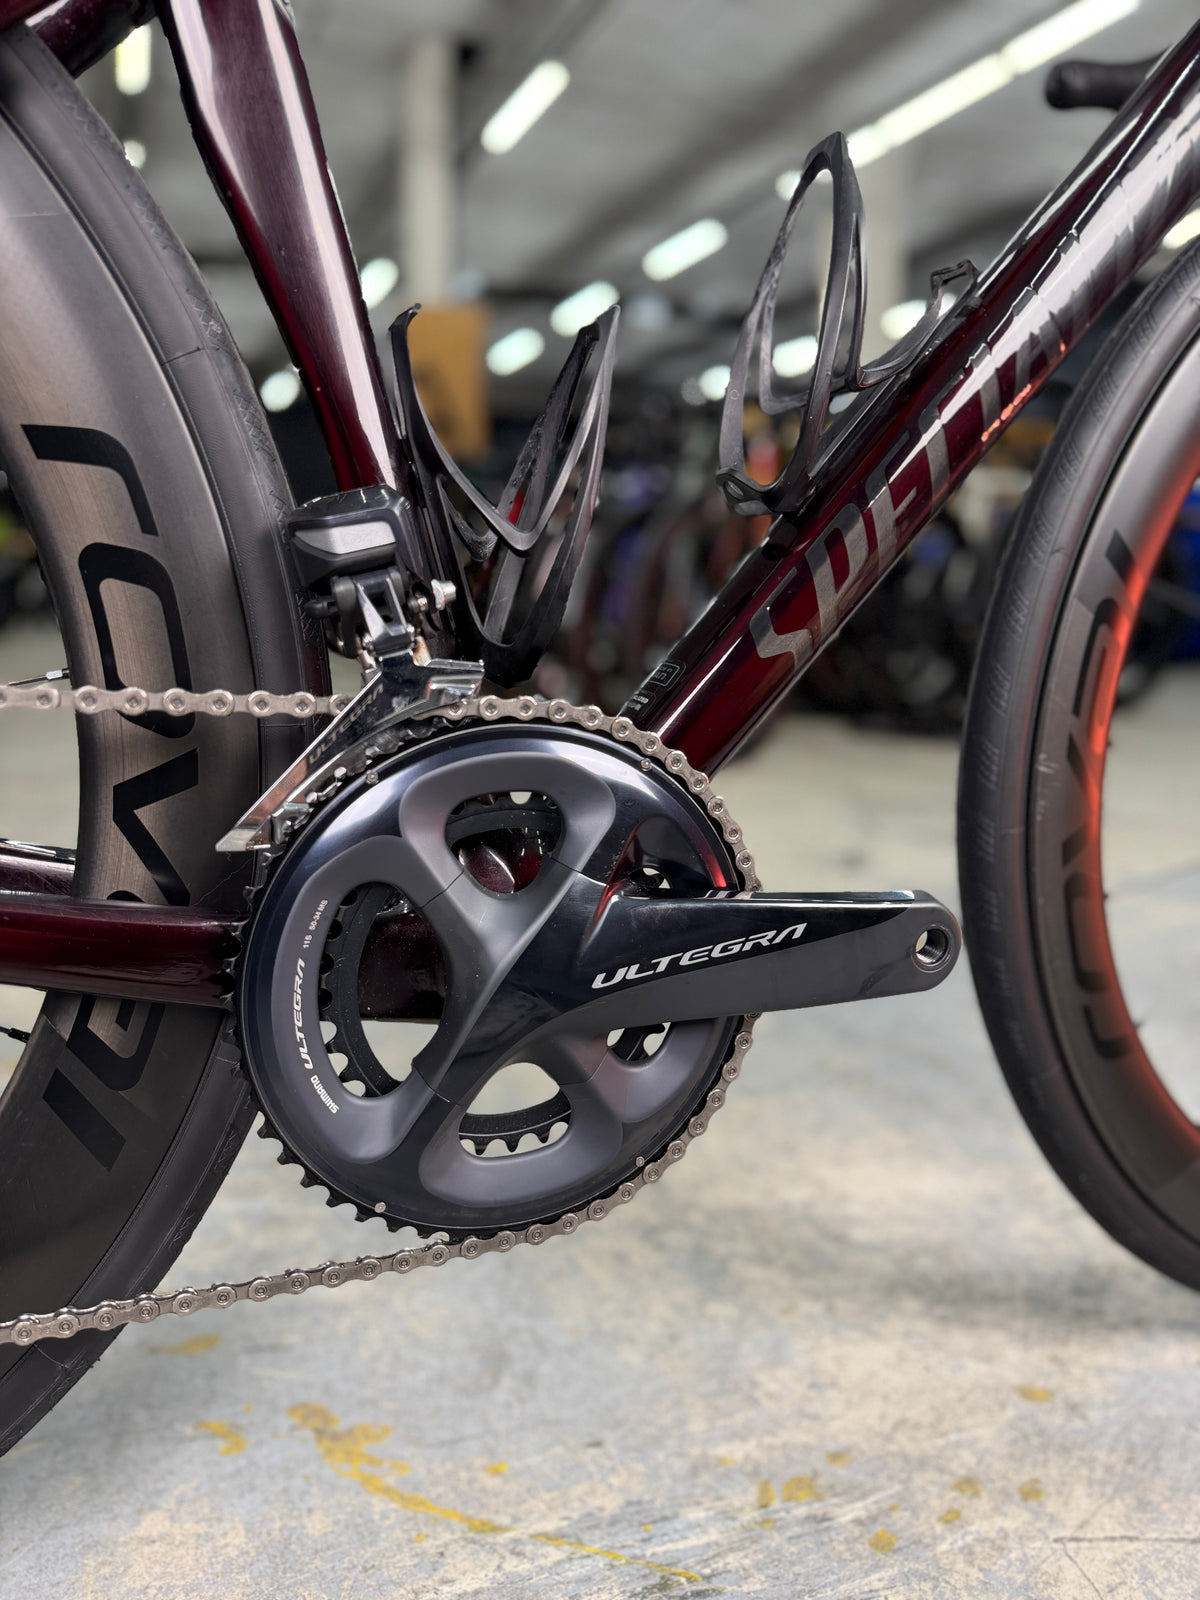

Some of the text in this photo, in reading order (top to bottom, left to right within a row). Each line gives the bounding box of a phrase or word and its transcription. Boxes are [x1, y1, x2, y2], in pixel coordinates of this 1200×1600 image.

[309, 684, 384, 764] ULTEGRA
[303, 934, 312, 948] 11S
[308, 911, 322, 930] 50-34
[591, 922, 808, 990] ULTEGRA
[292, 958, 314, 1070] ULTEGRA
[310, 1075, 339, 1114] SHIMANO
